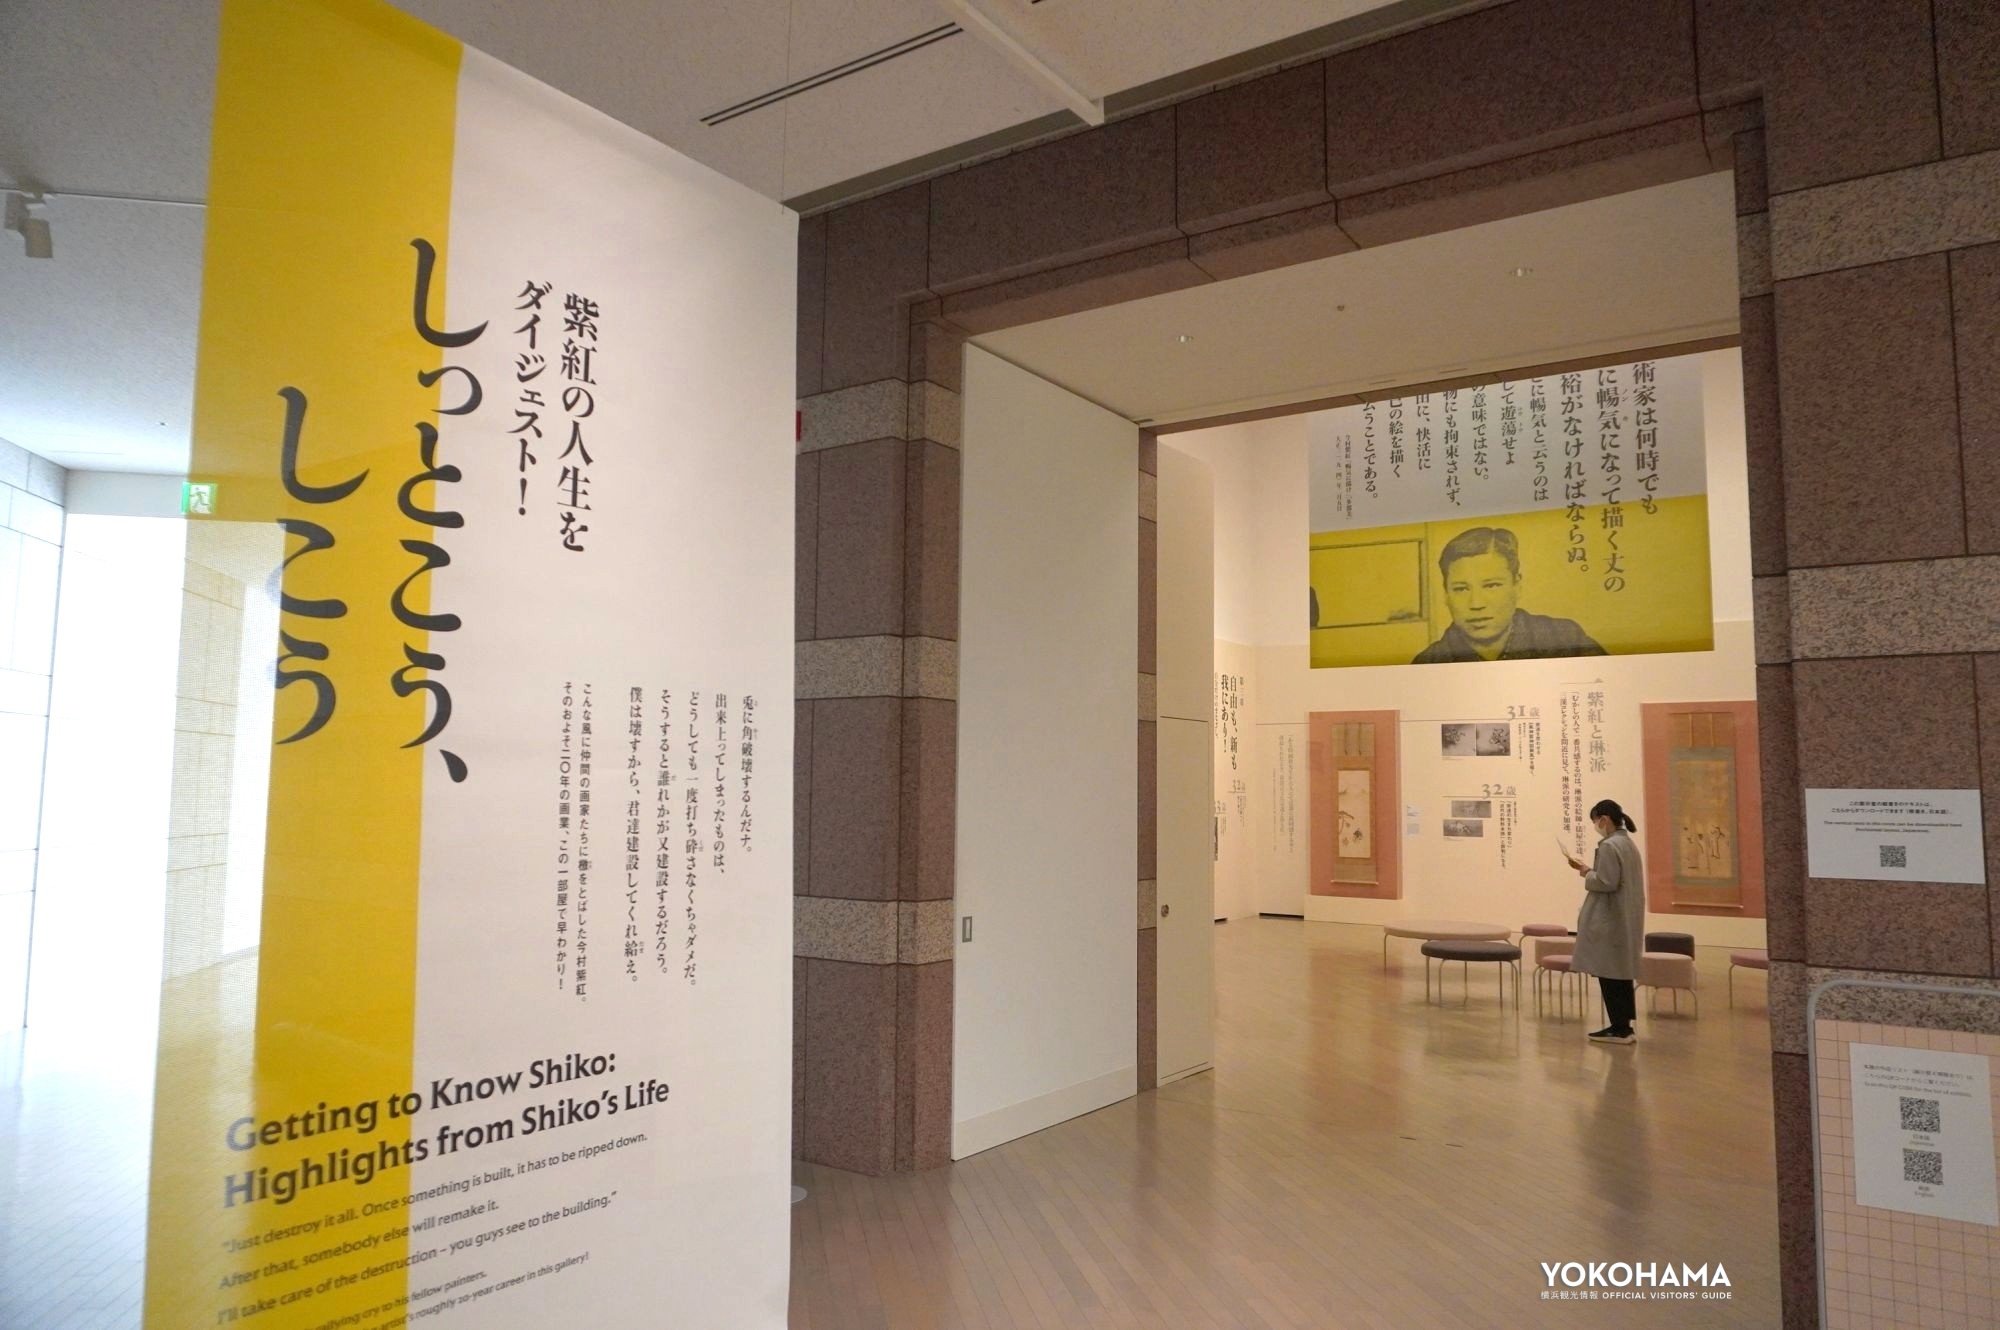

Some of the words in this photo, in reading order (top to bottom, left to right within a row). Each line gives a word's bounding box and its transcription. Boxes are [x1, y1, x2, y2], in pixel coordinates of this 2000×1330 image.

[506, 280, 553, 515] ダイジェスト！
[556, 292, 600, 552] 紫紅の人生を
[1632, 362, 1660, 515] 術家は何時でも
[389, 236, 489, 784] しっとこう、
[1560, 373, 1589, 572] 裕がなければならぬ。
[1596, 369, 1626, 593] に暢気になって描く丈の
[267, 385, 370, 746] しこう
[224, 1138, 428, 1209] Highlights
[437, 1118, 514, 1155] from
[521, 1089, 618, 1136] Shiko's
[625, 1079, 670, 1111] Life
[226, 1100, 379, 1151] Getting
[387, 1092, 422, 1119] to
[430, 1071, 523, 1110] Know
[529, 1053, 616, 1089] Shiko:
[218, 1269, 261, 1290] After
[263, 1259, 298, 1278] that,
[302, 1231, 380, 1267] somebody
[383, 1225, 409, 1242] else
[413, 1212, 435, 1233] will
[438, 1203, 485, 1226] remake
[487, 1200, 499, 1211] it.
[241, 1298, 277, 1317] take
[280, 1286, 314, 1306] care
[316, 1277, 334, 1295] of
[333, 1272, 357, 1290] the
[361, 1248, 437, 1281] destruction
[449, 1235, 474, 1256] you
[475, 1227, 505, 1247] guys
[506, 1221, 526, 1235] see
[528, 1216, 539, 1228] to
[541, 1211, 560, 1224] the
[562, 1190, 617, 1217] building."
[263, 1219, 322, 1244] destroy
[324, 1214, 335, 1228] it
[337, 1208, 360, 1224] all.
[362, 1199, 399, 1217] Once
[401, 1178, 471, 1207] something
[472, 1175, 482, 1187] is
[484, 1166, 515, 1185] built,
[517, 1162, 526, 1175] it
[527, 1157, 546, 1173] has
[548, 1154, 560, 1166] to
[561, 1149, 576, 1163] be
[578, 1140, 614, 1160] ripped
[616, 1132, 648, 1148] down.
[411, 1284, 443, 1303] fellow
[444, 1270, 487, 1293] painters.
[415, 1298, 456, 1318] roughly
[495, 1276, 526, 1291] career
[527, 1271, 536, 1281] in
[537, 1266, 554, 1276] this
[554, 1251, 590, 1273] gallery!
